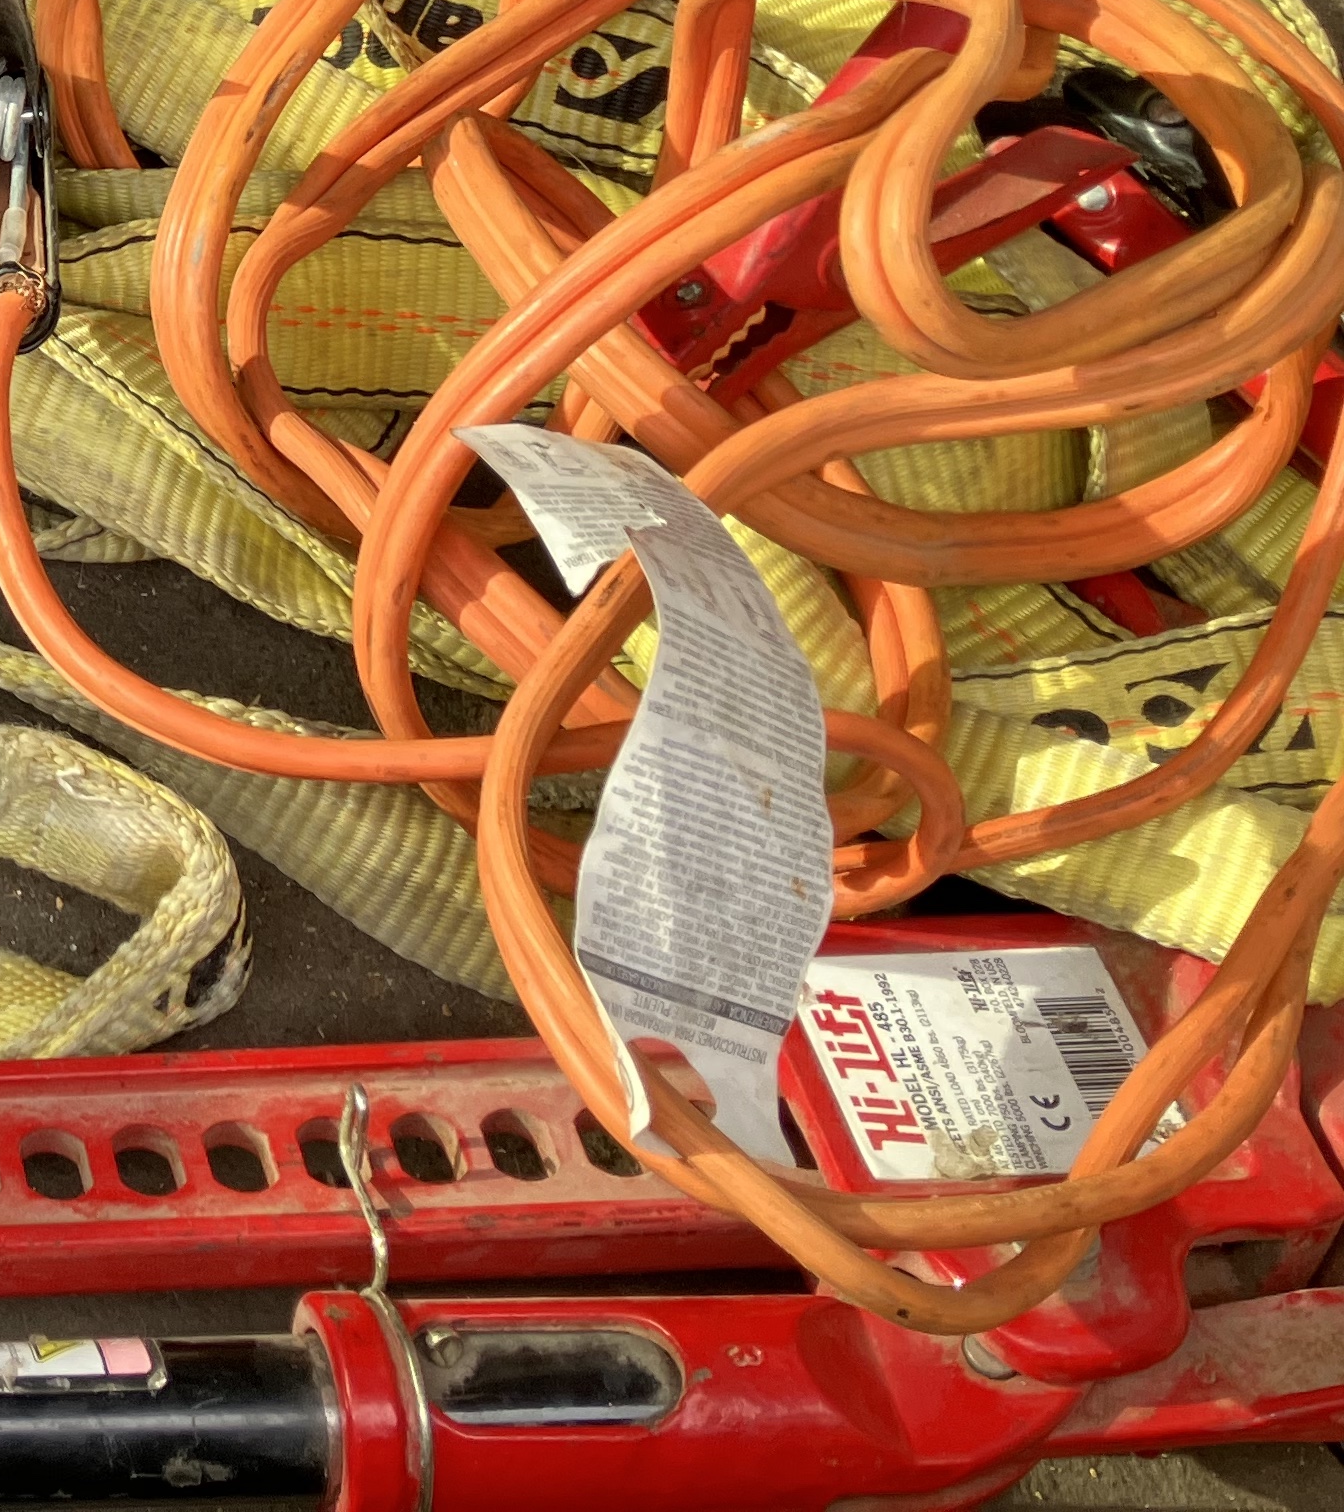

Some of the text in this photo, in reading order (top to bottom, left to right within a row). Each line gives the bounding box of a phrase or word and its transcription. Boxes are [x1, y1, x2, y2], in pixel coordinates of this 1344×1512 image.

[984, 958, 998, 978] USA
[874, 973, 916, 1042] B30.1-1992
[695, 1031, 768, 1065] INSTRUCCIONES
[868, 1002, 938, 1131] MODEL HL 485
[907, 1045, 951, 1116] ANSI/ASME
[945, 1072, 964, 1097] LOAD
[957, 1097, 978, 1126] RATED
